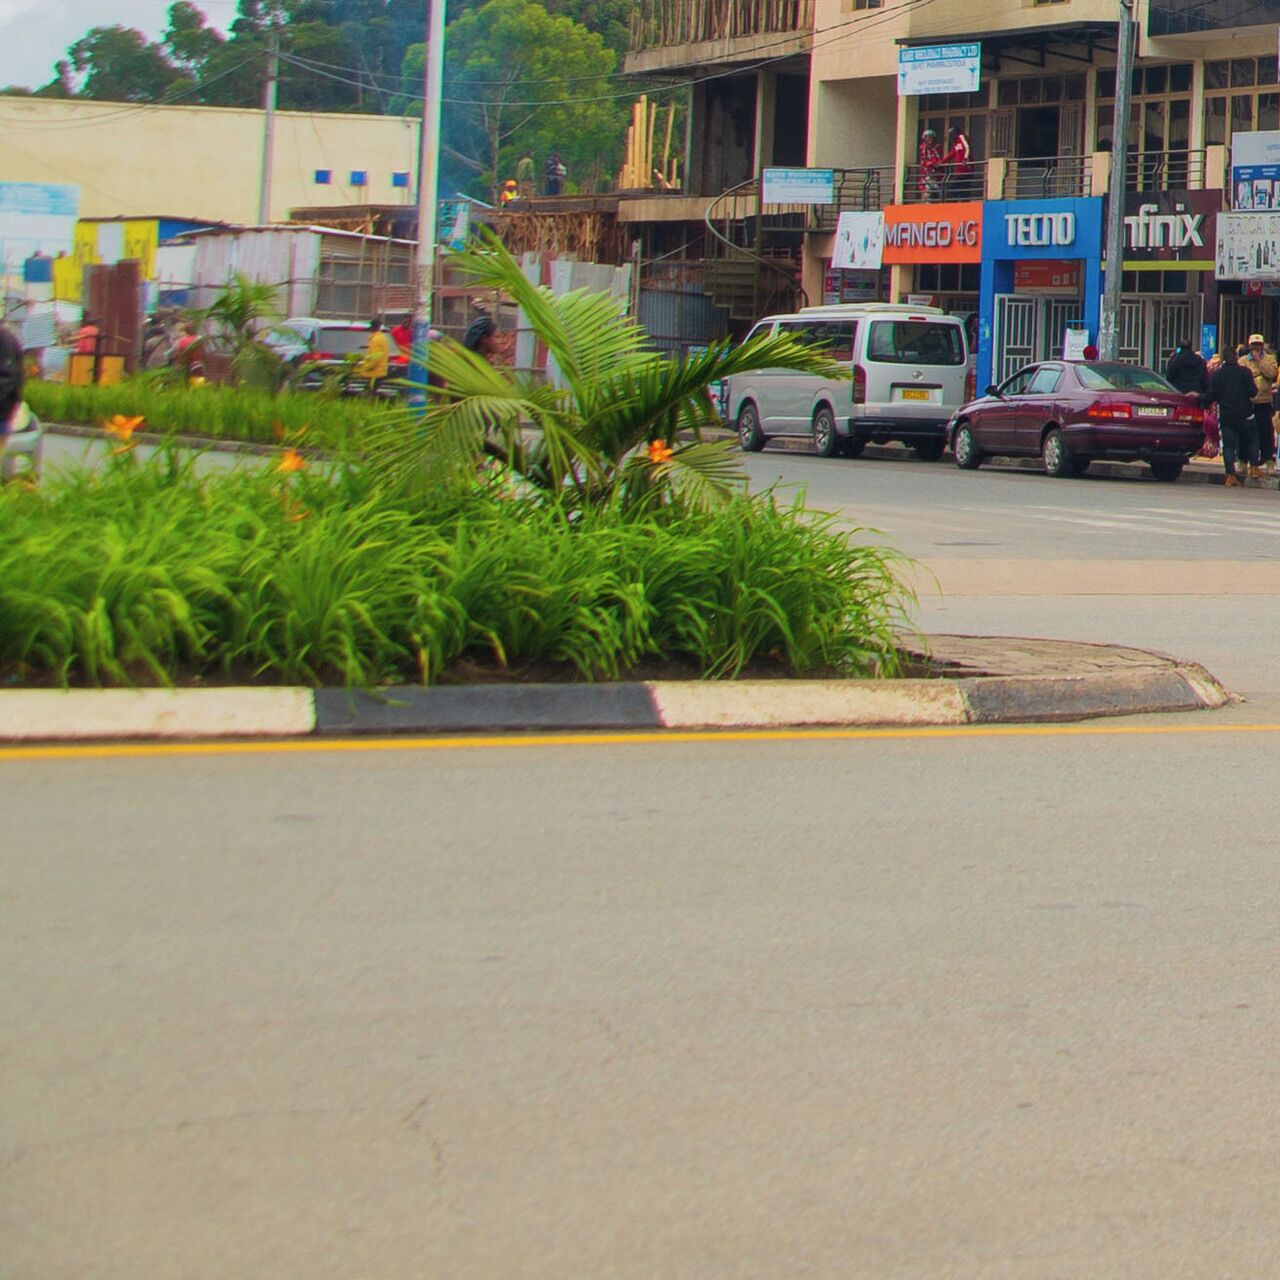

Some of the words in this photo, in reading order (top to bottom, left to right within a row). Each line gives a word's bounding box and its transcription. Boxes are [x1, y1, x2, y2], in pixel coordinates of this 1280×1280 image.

[884, 221, 951, 249] MANGO
[955, 220, 979, 247] 4G
[1004, 212, 1076, 247] TECNO
[1124, 203, 1205, 248] nfinix
